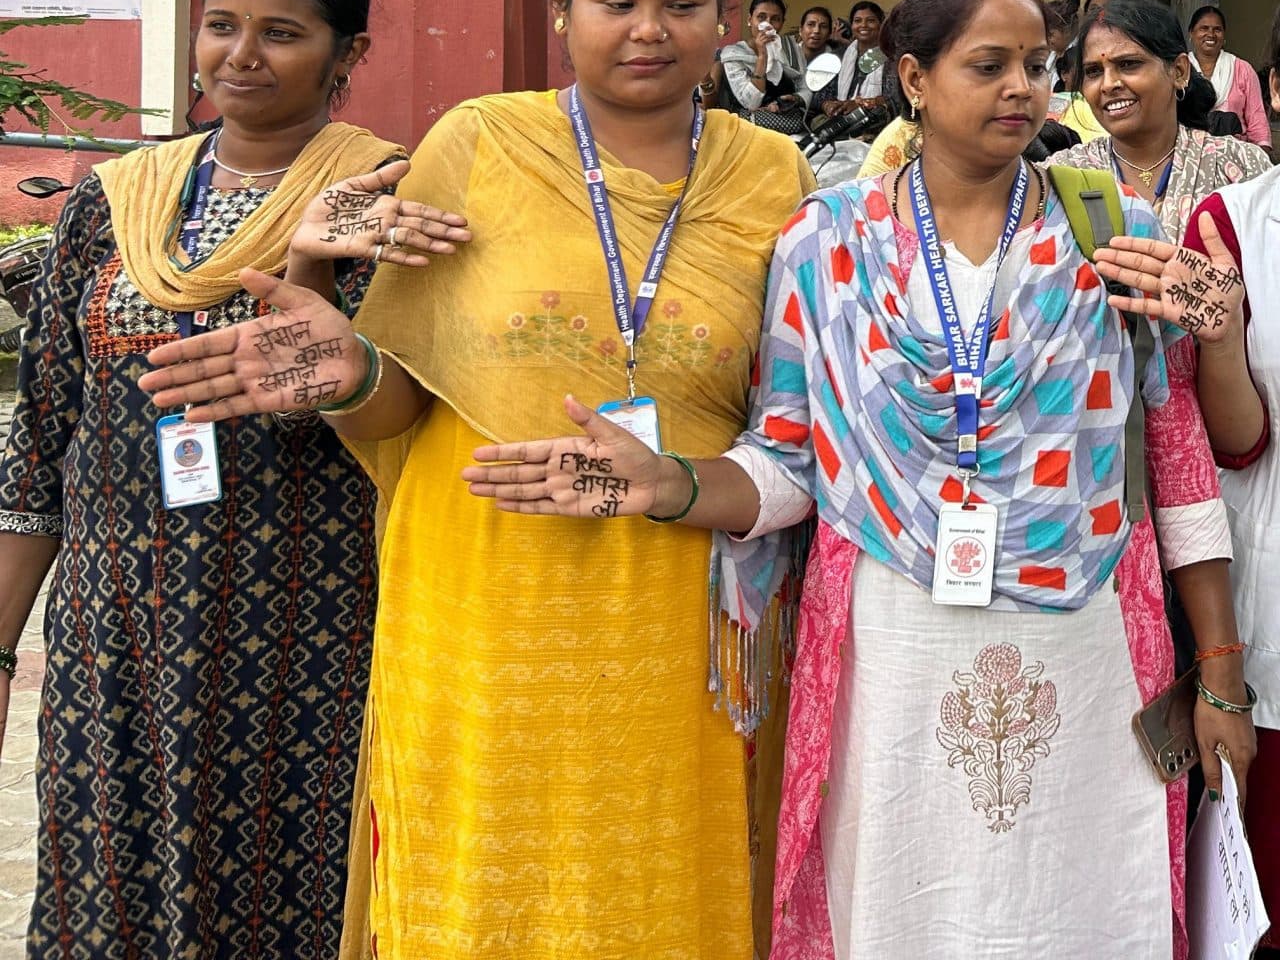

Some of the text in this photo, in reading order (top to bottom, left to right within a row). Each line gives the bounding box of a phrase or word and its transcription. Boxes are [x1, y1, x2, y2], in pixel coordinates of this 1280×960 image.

[593, 185, 605, 202] Bihar
[922, 219, 942, 269] HEALTH
[1176, 249, 1207, 272] NHM
[934, 271, 957, 322] SARKAR
[618, 305, 630, 331] Health
[950, 326, 968, 366] BIHAR
[560, 452, 613, 473] FRAS
